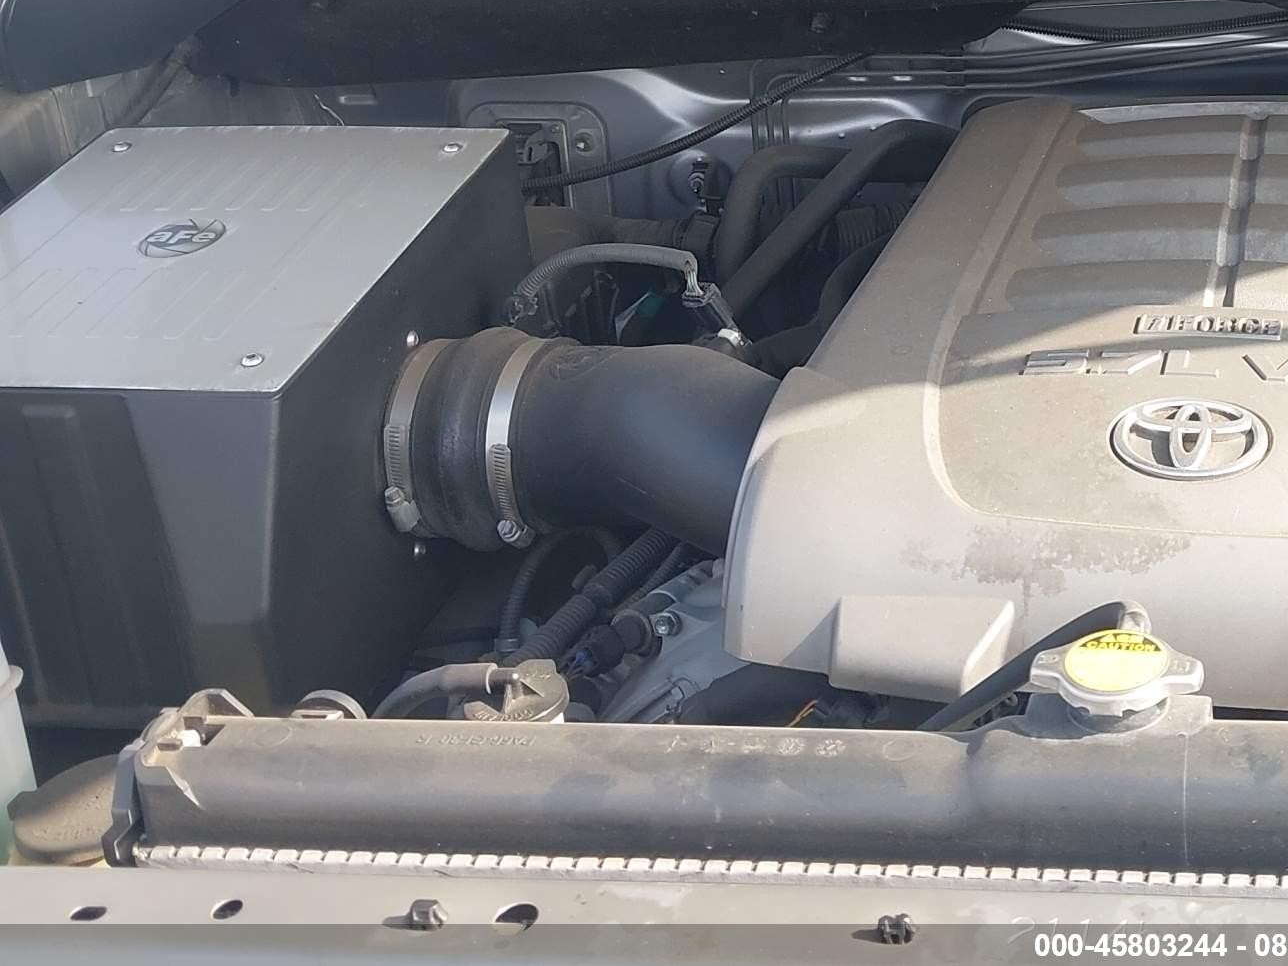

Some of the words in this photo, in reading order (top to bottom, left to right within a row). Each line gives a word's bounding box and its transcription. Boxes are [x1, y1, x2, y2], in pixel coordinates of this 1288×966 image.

[146, 230, 216, 244] aFe
[1019, 349, 1221, 379] 5.7L
[1086, 641, 1156, 652] CAUTION
